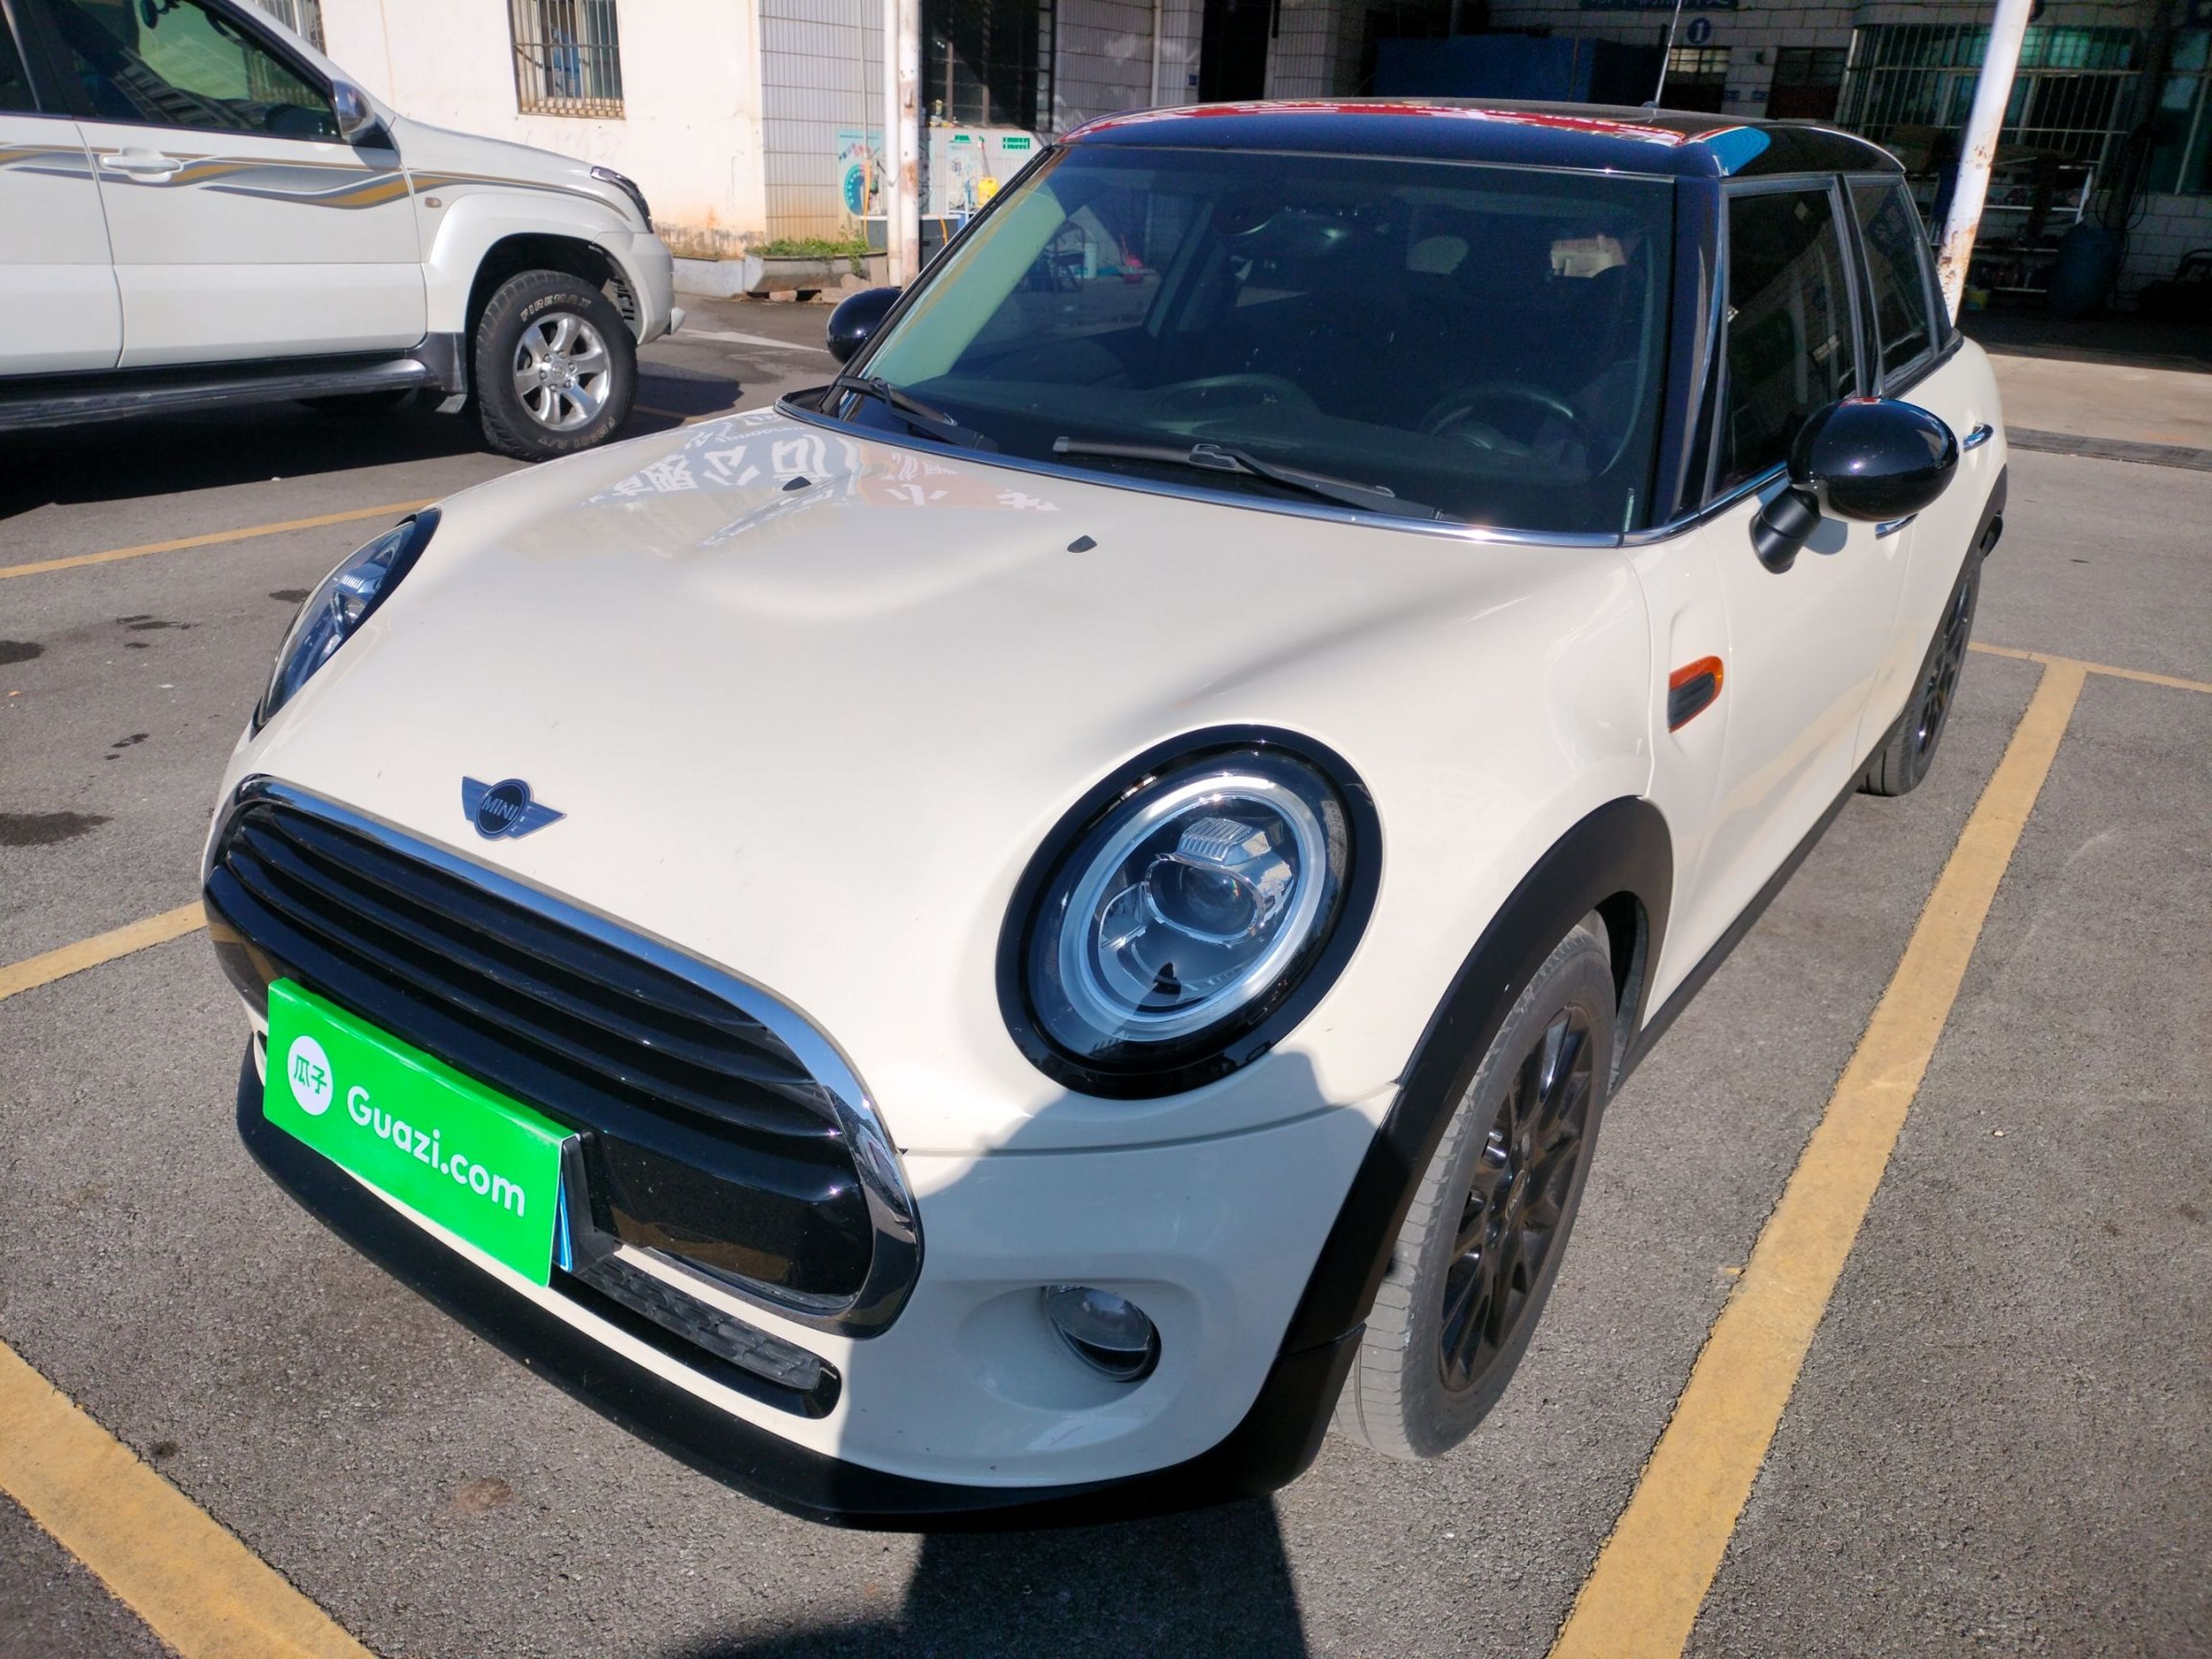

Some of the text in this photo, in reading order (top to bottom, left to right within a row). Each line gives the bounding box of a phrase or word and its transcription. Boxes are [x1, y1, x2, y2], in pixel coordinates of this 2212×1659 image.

[482, 796, 518, 821] MINI
[293, 1054, 327, 1094] 瓜子
[347, 1085, 525, 1218] Guazi.com
